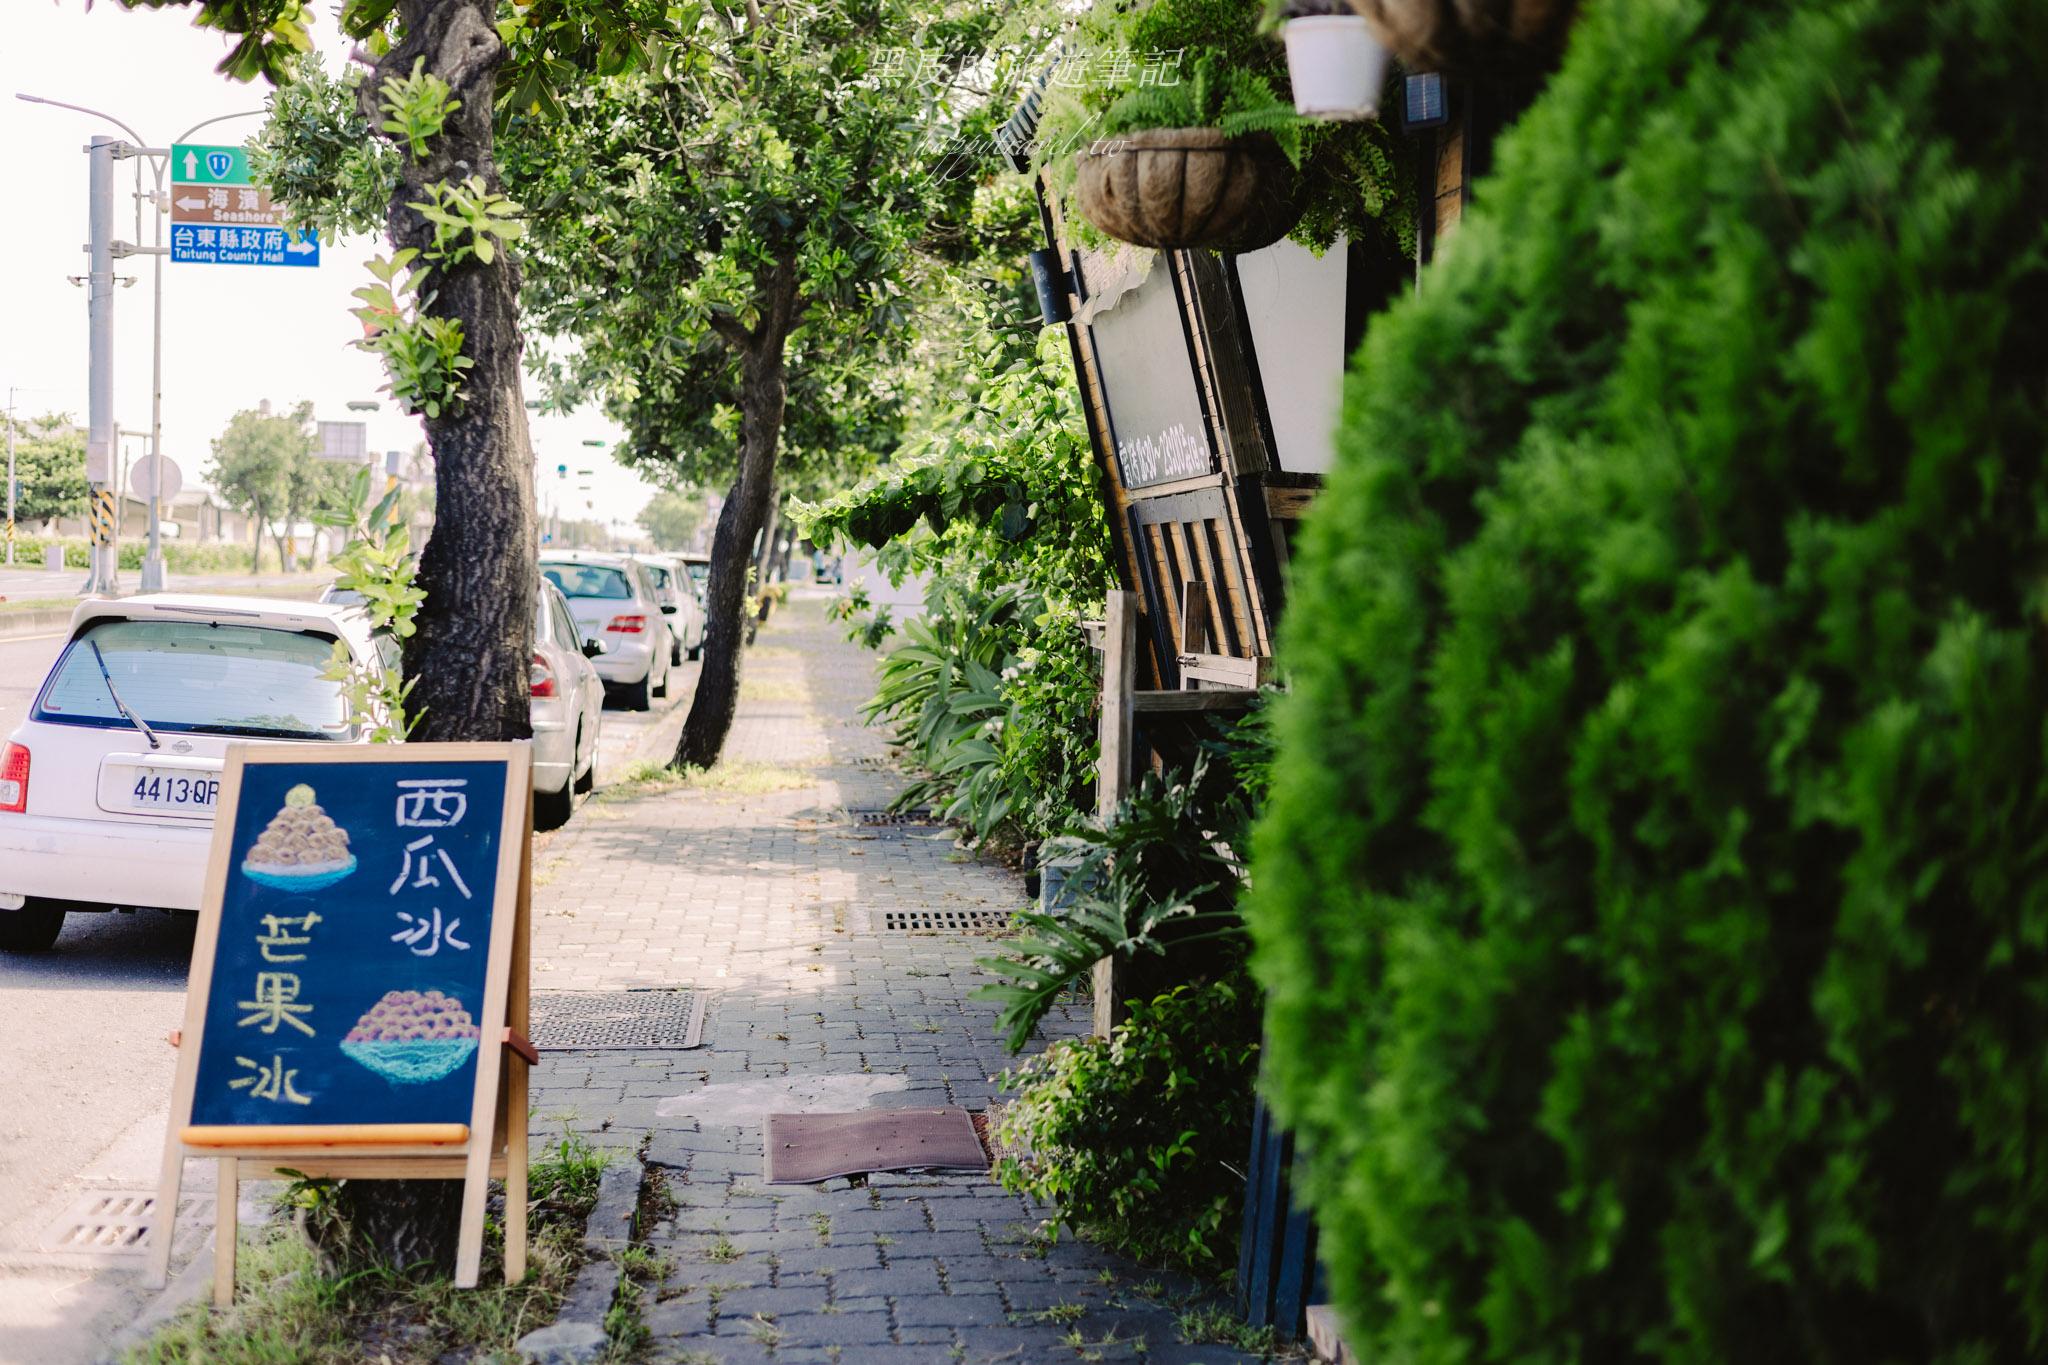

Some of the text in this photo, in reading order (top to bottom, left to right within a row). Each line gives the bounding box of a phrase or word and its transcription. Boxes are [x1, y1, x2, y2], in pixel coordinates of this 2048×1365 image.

[212, 157, 226, 170] 11
[213, 209, 274, 223] Seashore
[174, 227, 284, 251] 台東縣政府
[174, 247, 284, 264] Taitung County Hall
[390, 778, 472, 958] 西瓜冰
[228, 911, 322, 1105] 芒果冰
